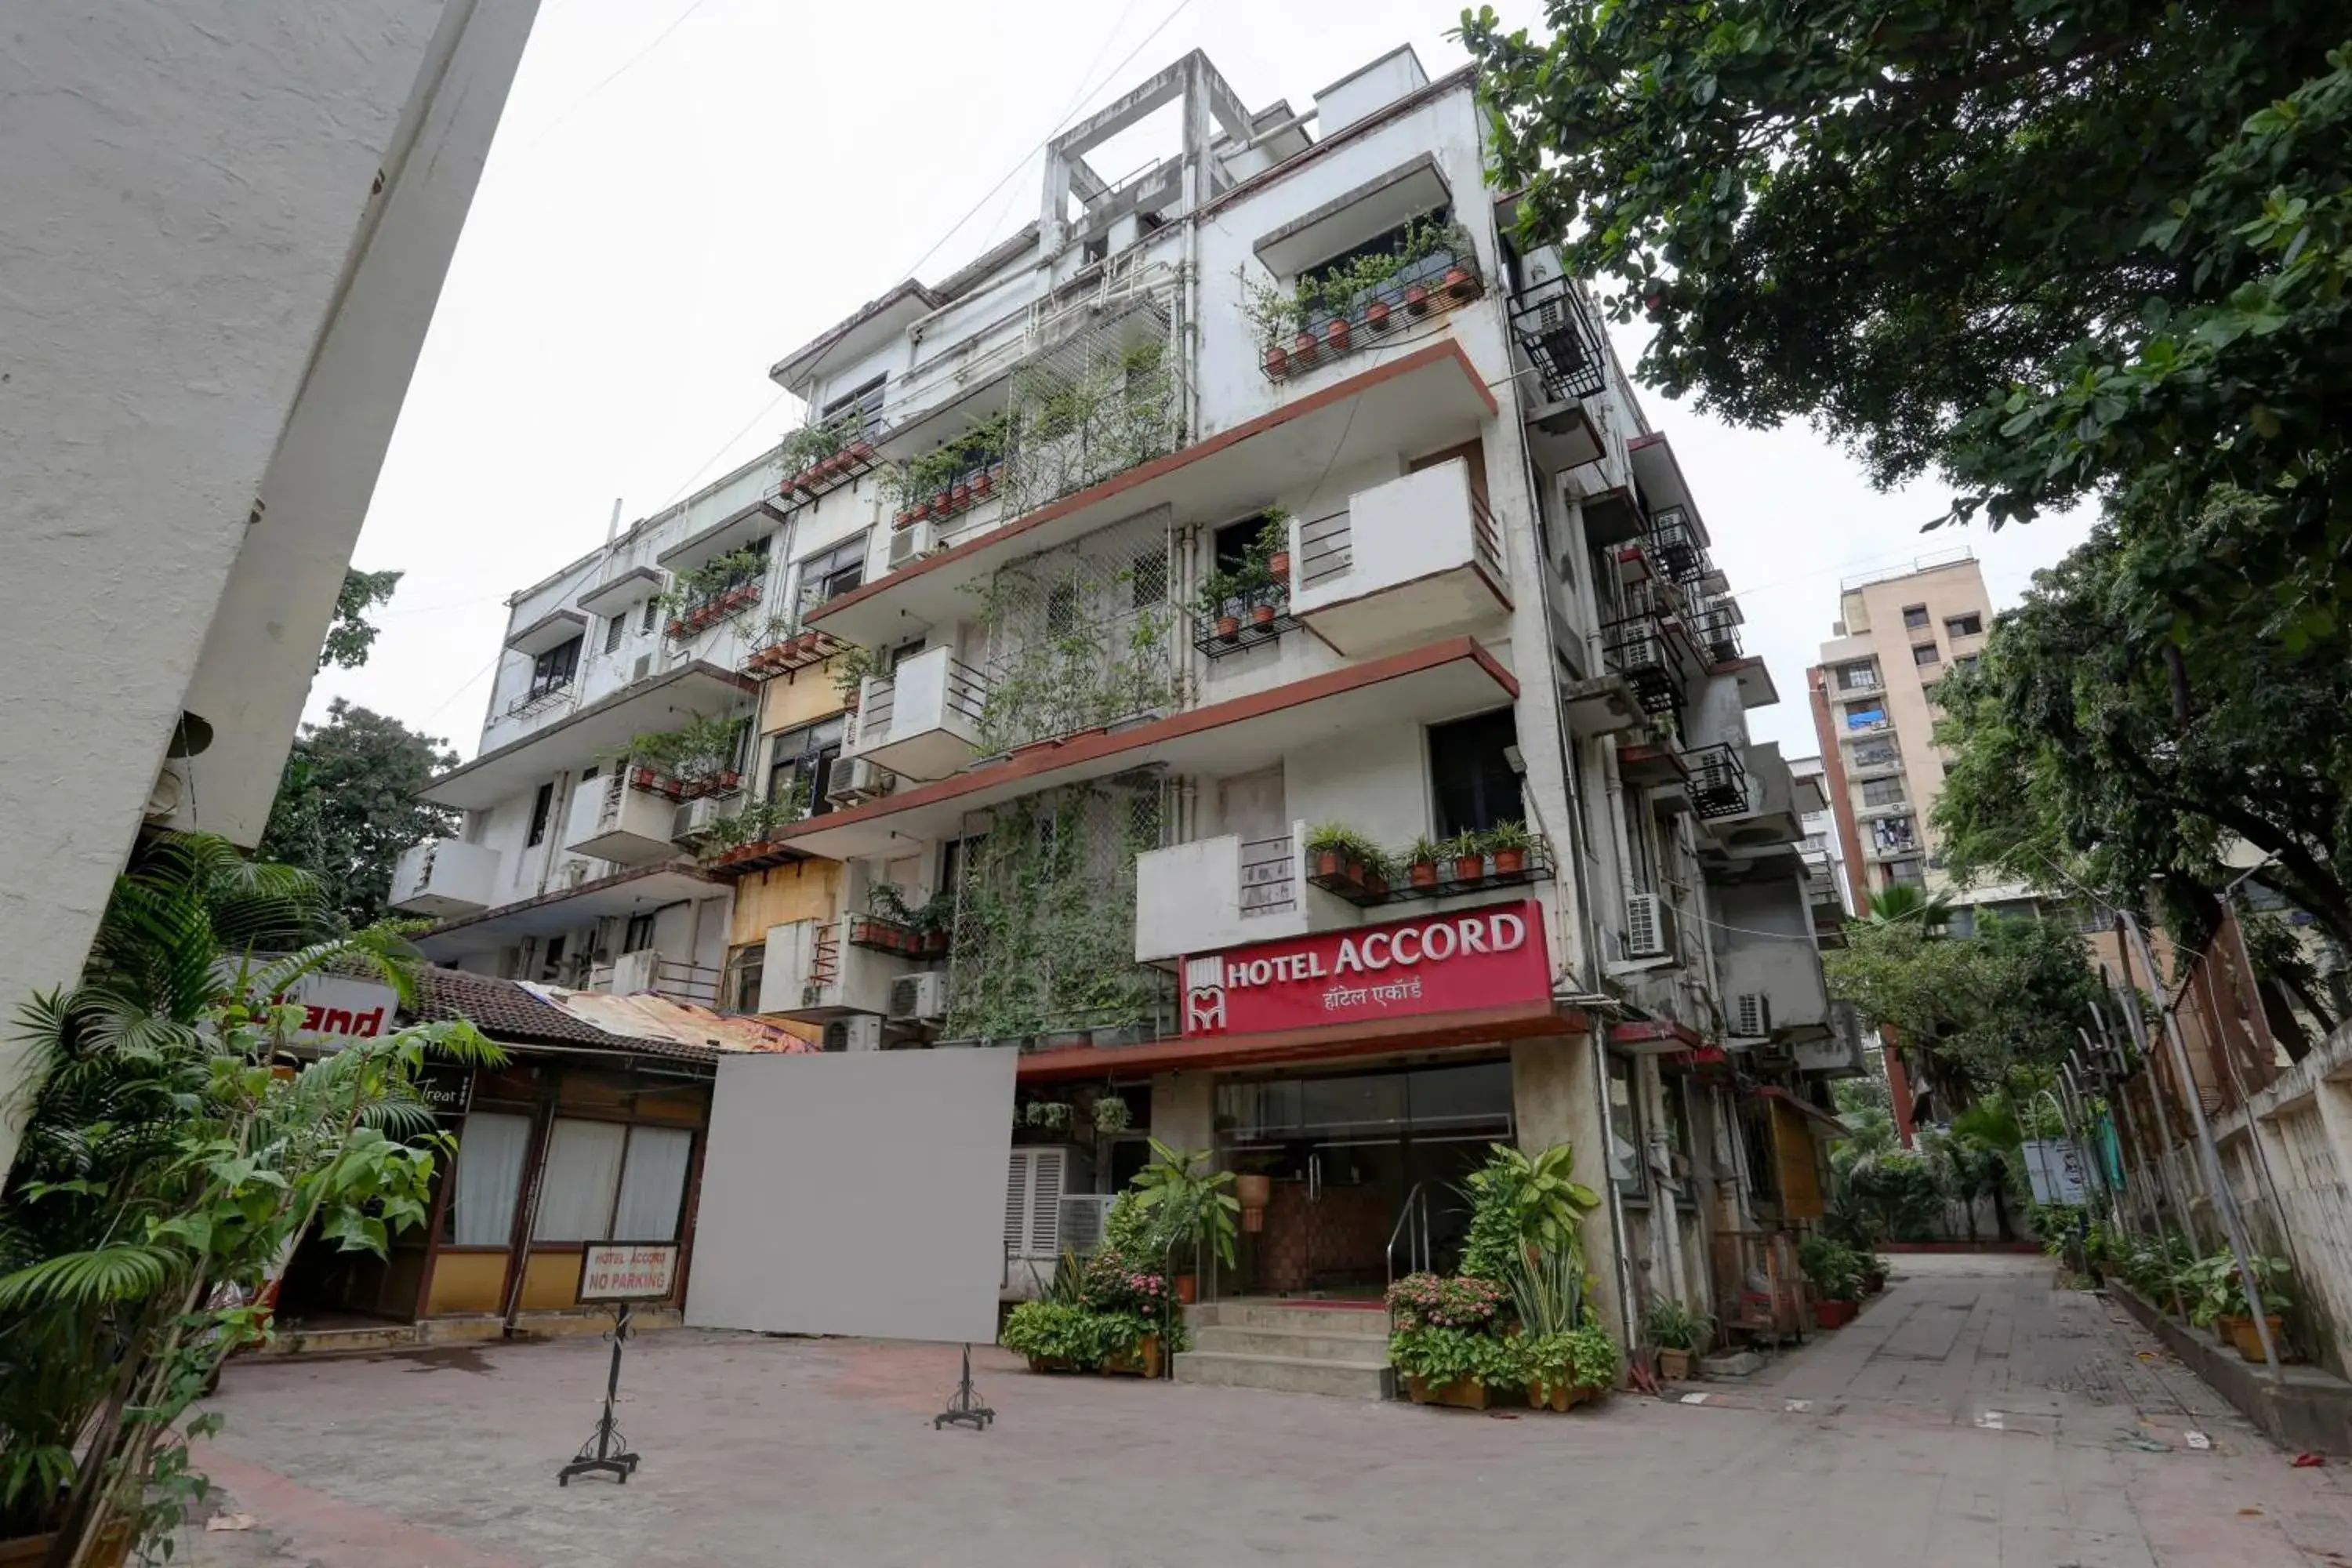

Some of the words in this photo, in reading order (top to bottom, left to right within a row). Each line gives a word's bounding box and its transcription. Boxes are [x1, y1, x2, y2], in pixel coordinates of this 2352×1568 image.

[1228, 952, 1327, 988] HOTEL
[1334, 913, 1526, 975] ACCORD
[1322, 985, 1368, 1011] हॉटेल
[595, 1252, 624, 1265] HOTEL
[589, 1272, 608, 1290] NO
[612, 1272, 666, 1290] PARKING
